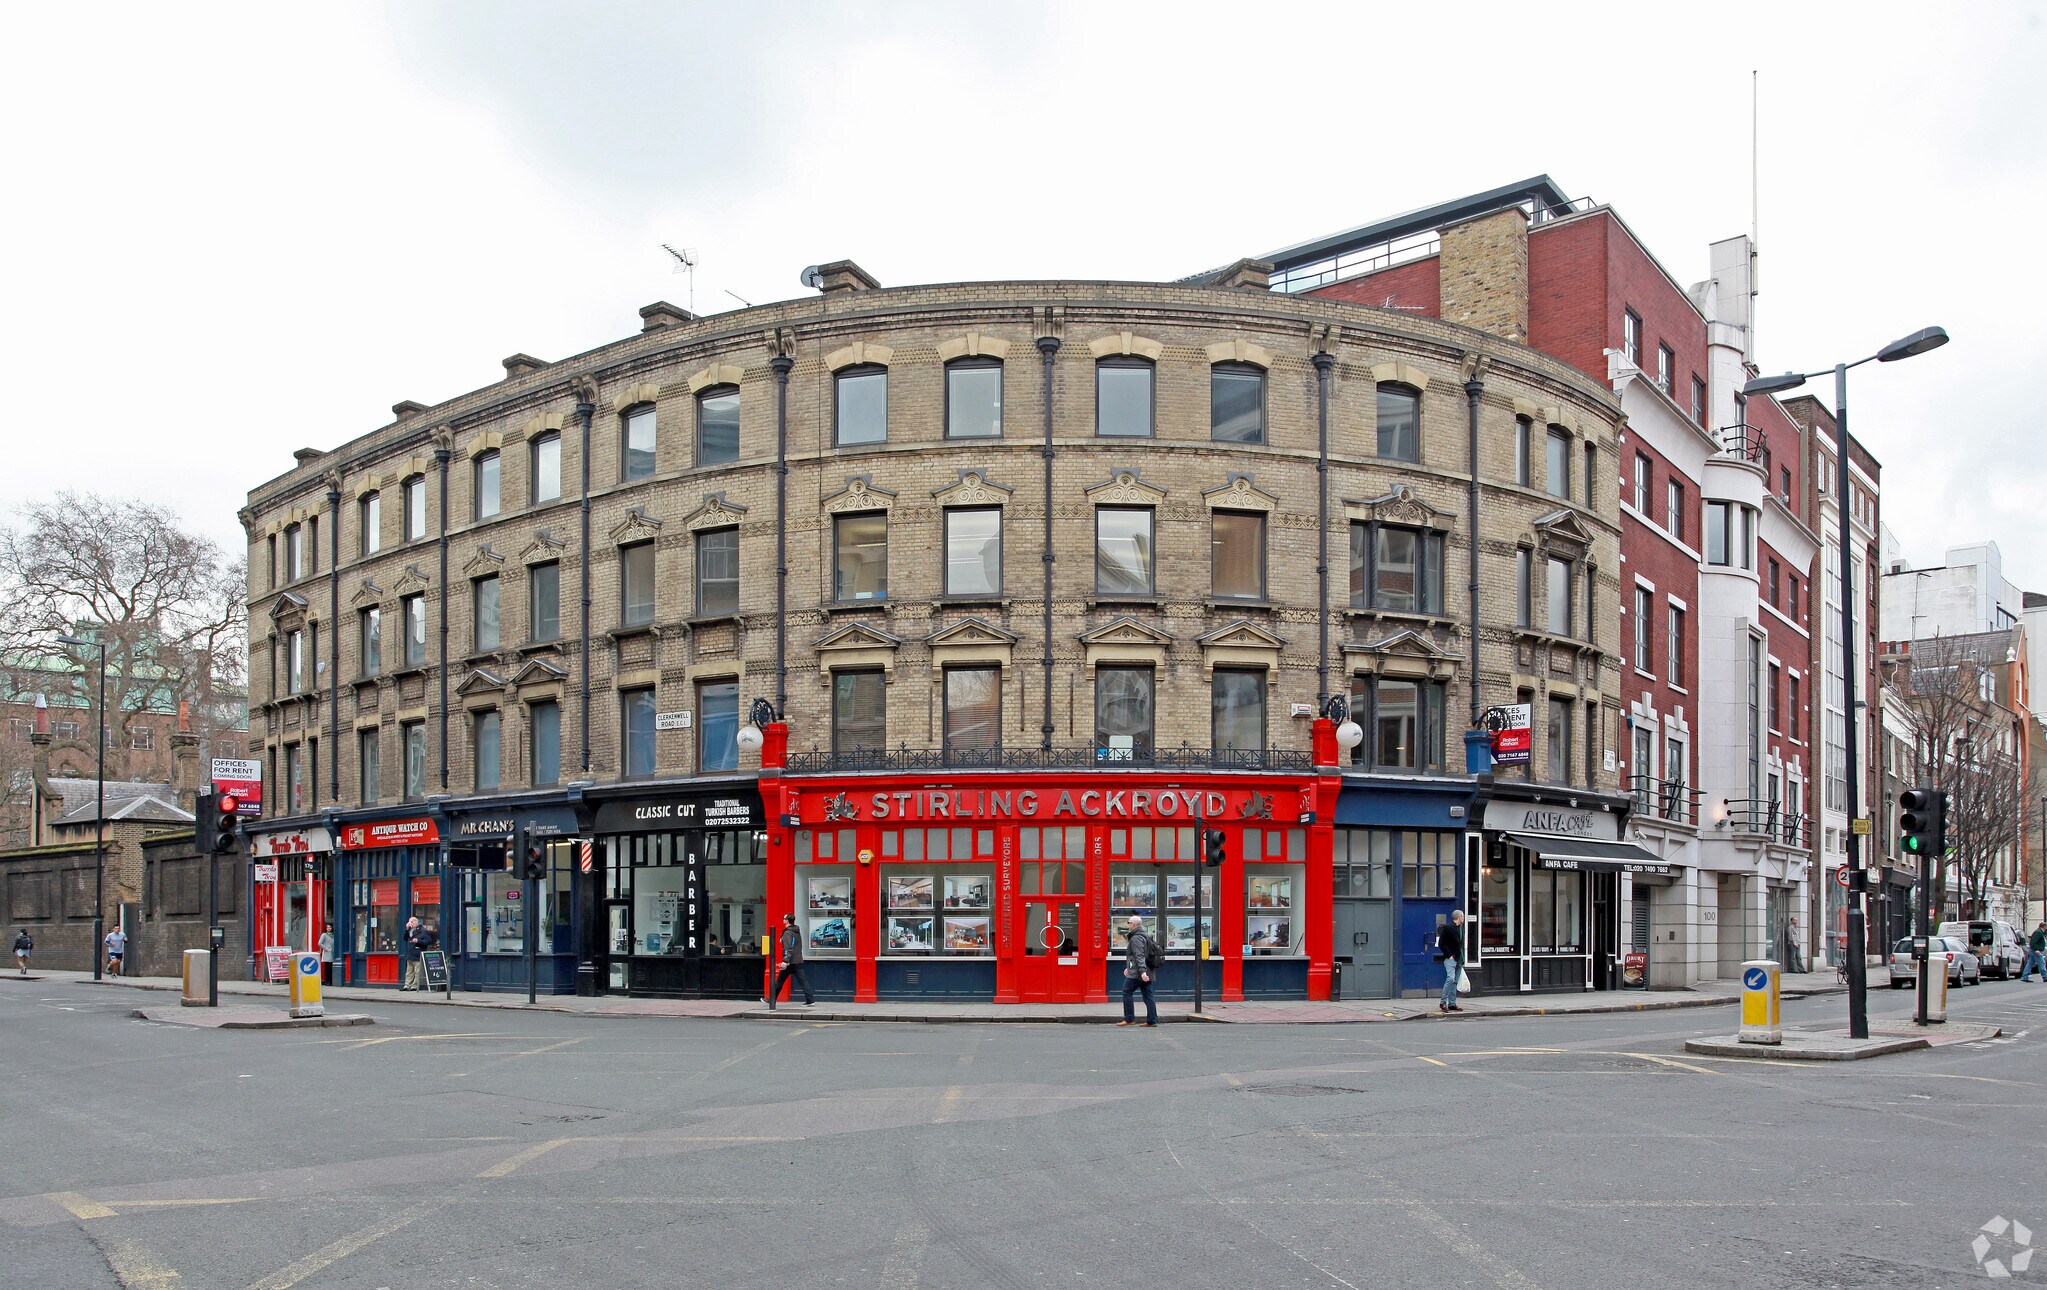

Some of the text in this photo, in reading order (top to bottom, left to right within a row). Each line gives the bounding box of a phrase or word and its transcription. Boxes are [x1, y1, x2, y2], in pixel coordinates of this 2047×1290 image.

[714, 799, 740, 807] TRADITIONAL
[871, 789, 1227, 818] STIRLING ACKROYD
[636, 804, 695, 819] CLASSIC CUT
[705, 806, 749, 816] TURKISH BARBERS
[461, 823, 477, 834] MR
[478, 820, 514, 833] CHAN'S
[1523, 811, 1568, 832] ANFA
[371, 822, 428, 836] ANTIQUE WATCH CO
[1003, 836, 1011, 891] SURVEYORS
[1545, 860, 1578, 868] ANFA CAFE
[1840, 871, 1848, 881] 2
[688, 853, 697, 949] BARBER
[1704, 912, 1716, 920] 100
